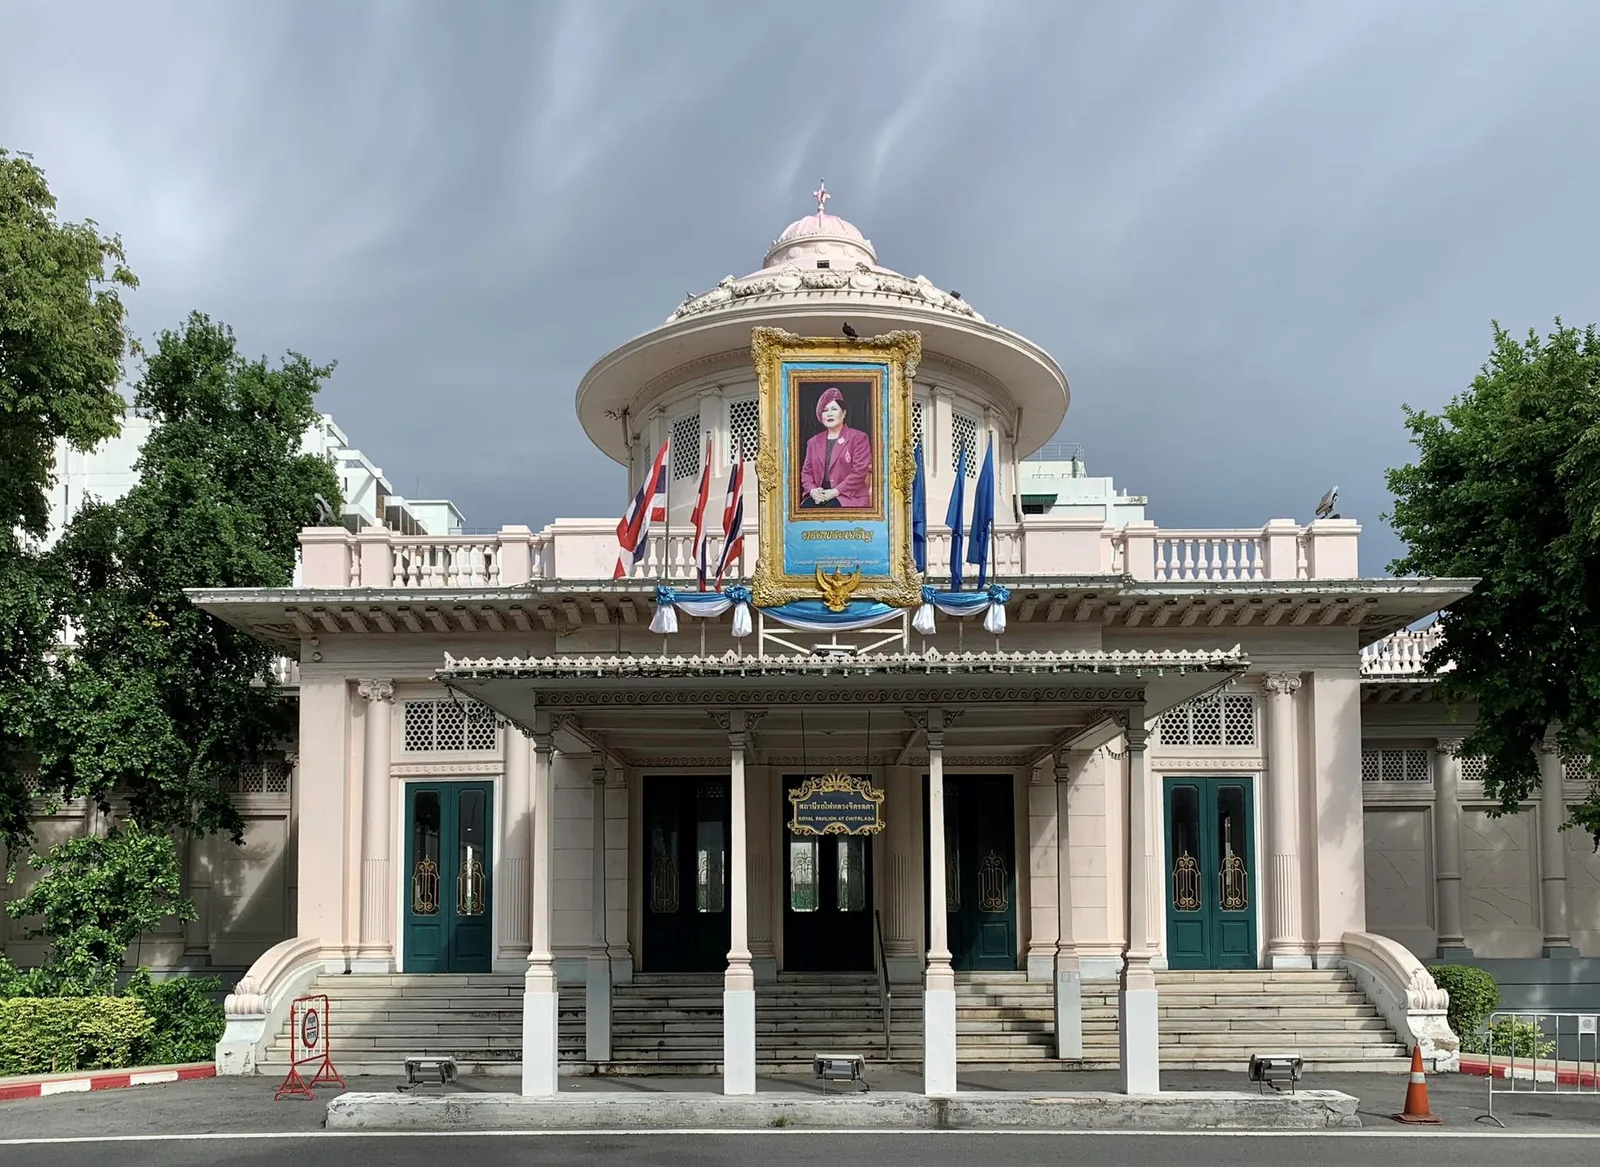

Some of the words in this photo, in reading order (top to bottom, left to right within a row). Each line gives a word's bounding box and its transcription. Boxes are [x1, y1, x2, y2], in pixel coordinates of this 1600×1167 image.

[801, 527, 874, 543] ทรงพระเจริญ
